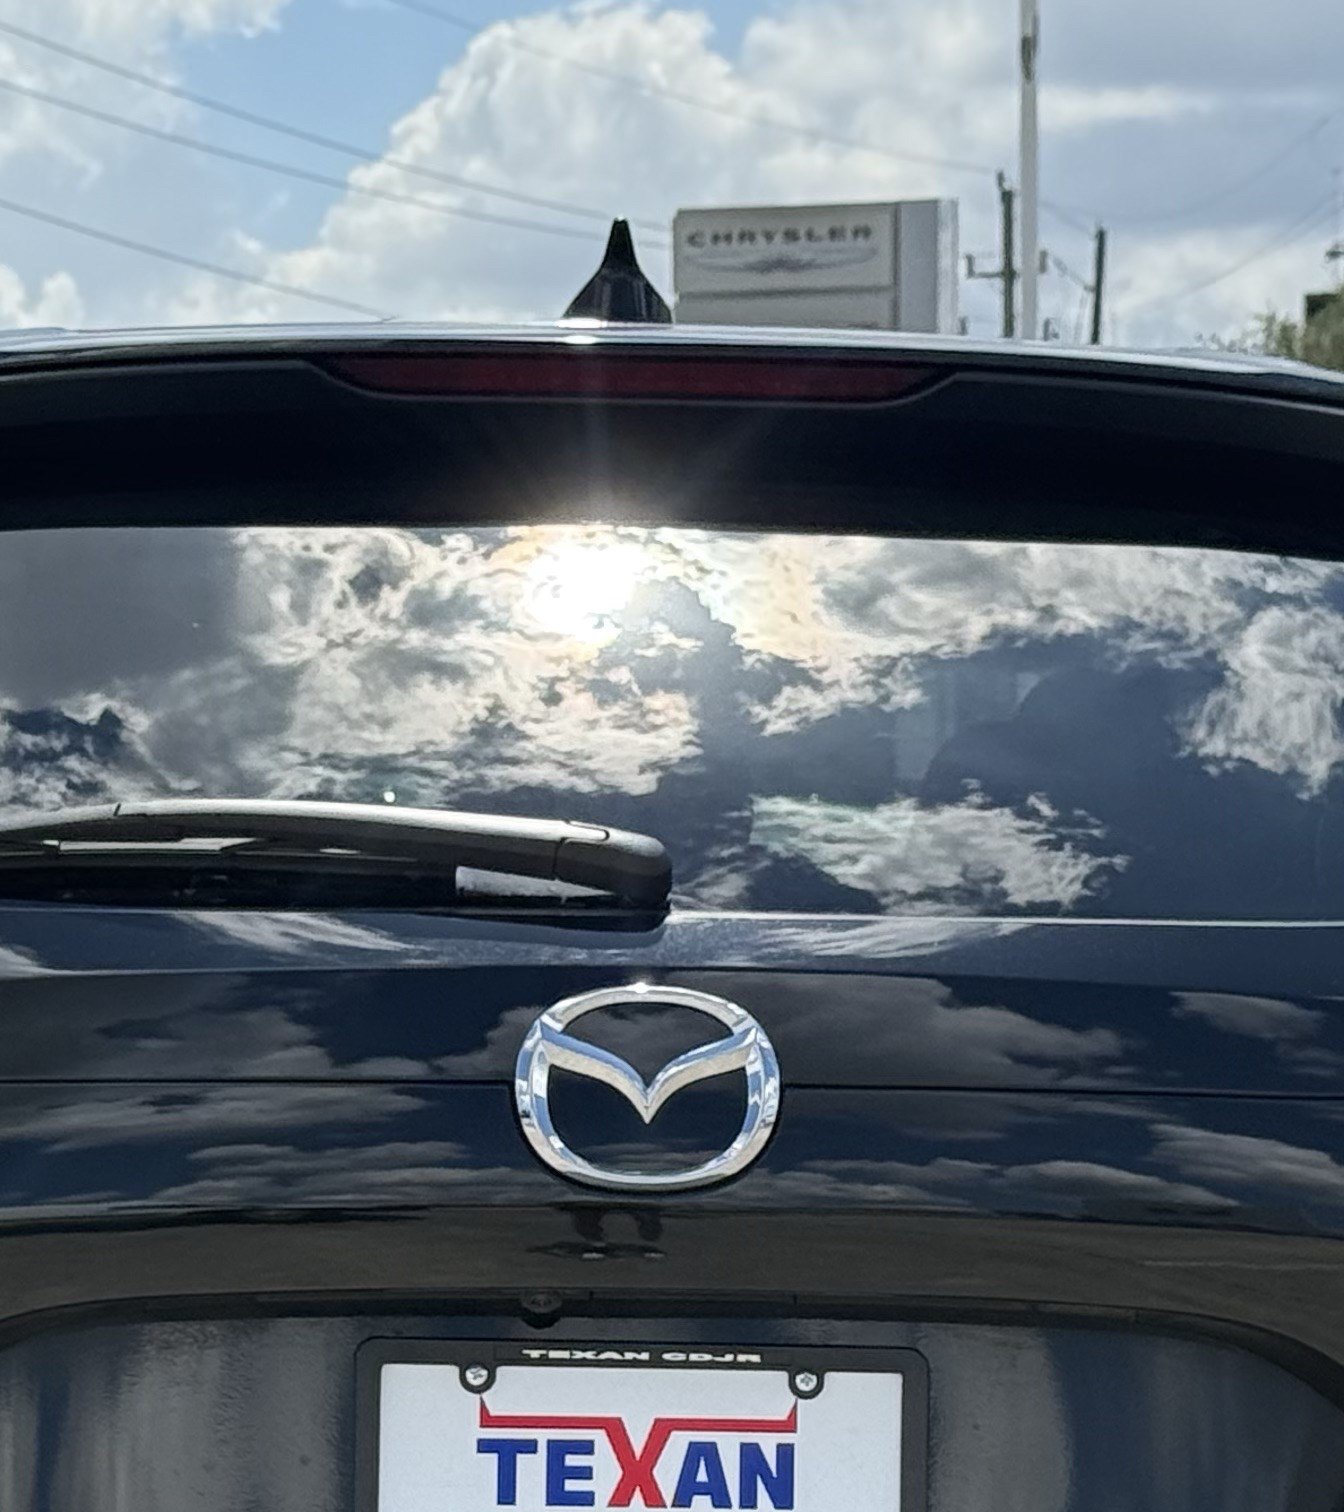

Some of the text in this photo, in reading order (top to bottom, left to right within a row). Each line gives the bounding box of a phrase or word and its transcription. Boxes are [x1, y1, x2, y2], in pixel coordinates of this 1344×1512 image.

[687, 224, 872, 249] CHRYSLER
[522, 1349, 651, 1361] TEXAN
[477, 1402, 799, 1510] TEXAN
